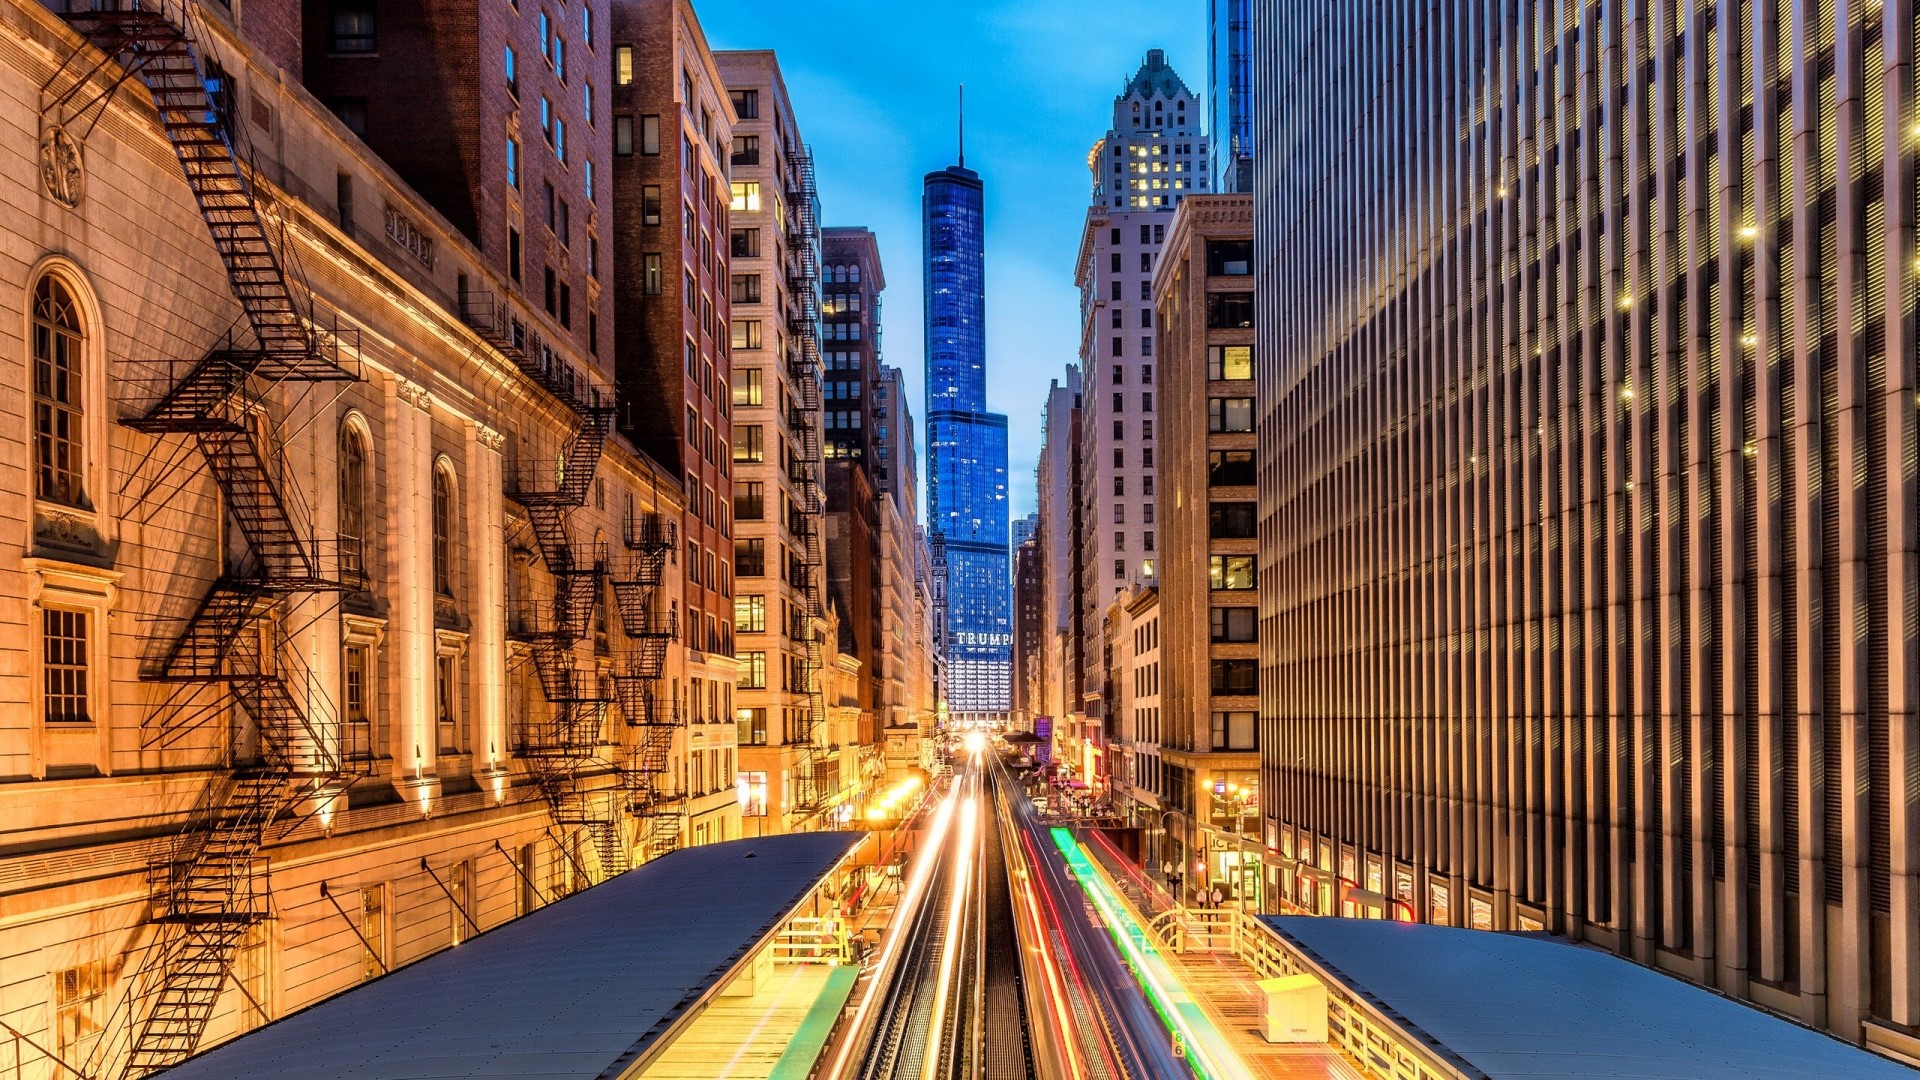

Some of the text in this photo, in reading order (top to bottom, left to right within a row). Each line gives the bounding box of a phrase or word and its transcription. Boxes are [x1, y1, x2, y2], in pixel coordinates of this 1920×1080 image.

[957, 632, 1010, 645] TRUMP
[1211, 839, 1225, 848] IC
[1175, 1033, 1182, 1042] 8
[1175, 1045, 1182, 1055] 6
